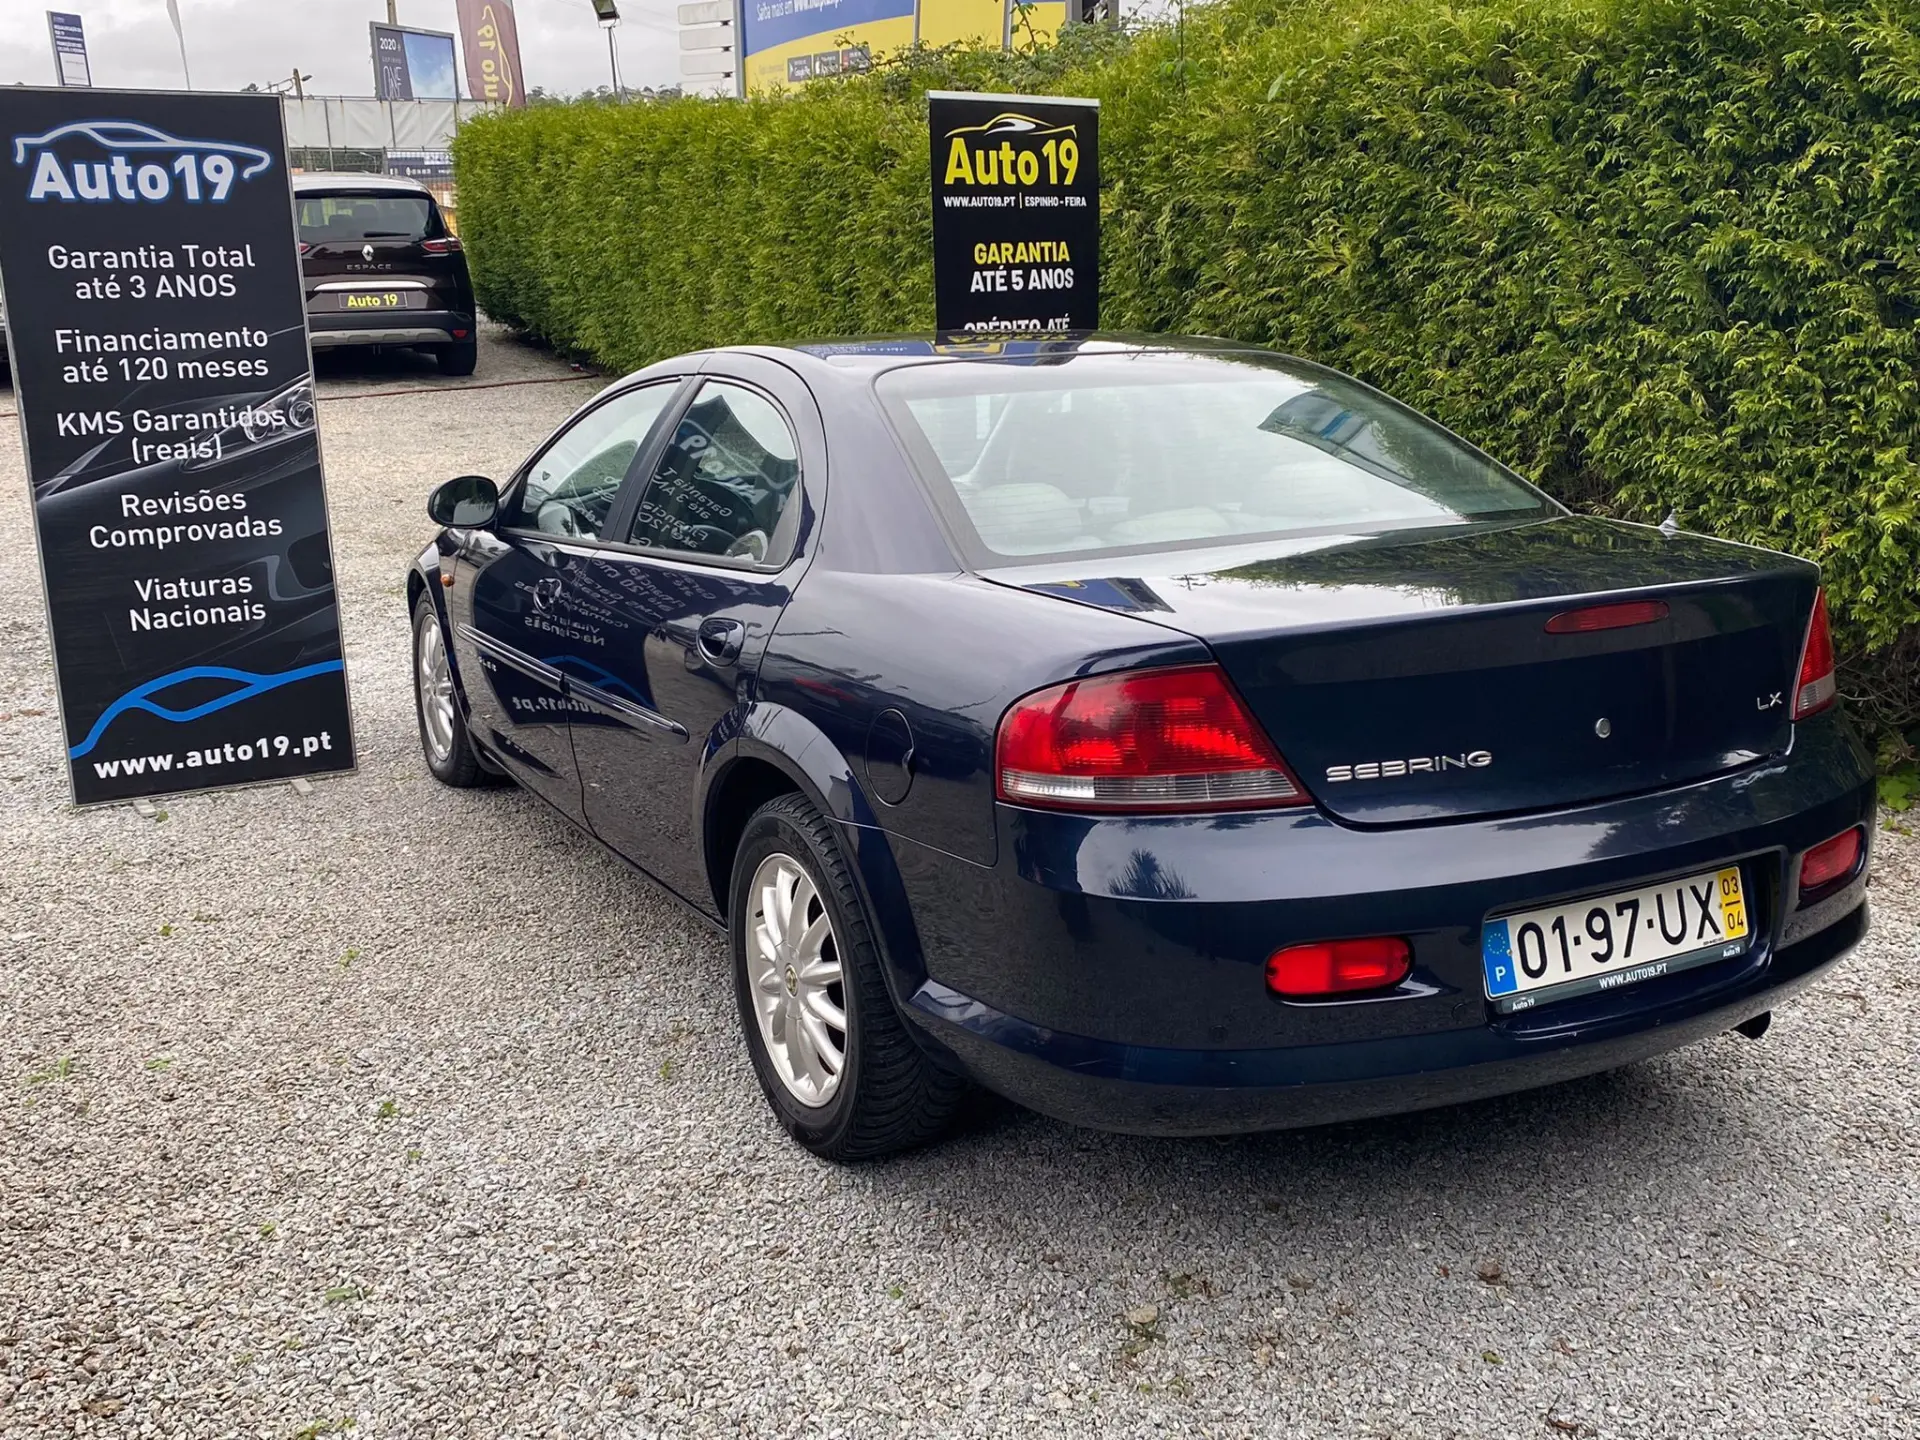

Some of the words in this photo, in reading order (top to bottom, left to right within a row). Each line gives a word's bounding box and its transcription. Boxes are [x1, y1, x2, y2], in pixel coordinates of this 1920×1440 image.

[380, 37, 397, 51] 2020
[943, 196, 1015, 208] WWW.AUTO19.PT
[1025, 196, 1058, 207] ESPINHO
[1064, 196, 1087, 207] FEIRA
[48, 245, 175, 269] Garantia
[182, 244, 255, 267] Total
[974, 241, 1070, 265] GARANTIA
[75, 275, 121, 300] até
[130, 276, 146, 298] 3
[155, 274, 237, 298] ANOS
[970, 265, 1008, 293] ATÉ
[1011, 269, 1024, 292] 5
[1028, 267, 1074, 290] ANOS
[55, 327, 269, 353] Financiamento
[63, 359, 108, 384] até
[118, 357, 168, 381] 120
[177, 358, 269, 379] meses
[57, 411, 124, 437] KMS
[132, 405, 287, 434] Garantidos
[131, 434, 222, 464] (reais)
[121, 489, 247, 517] Revisões
[89, 516, 283, 549] Comprovadas
[134, 575, 253, 602] Viaturas
[129, 600, 267, 632] Nacionais
[1756, 691, 1783, 711] LX
[93, 731, 332, 779] www.auto19.pt
[1326, 750, 1493, 783] SEBRING
[1722, 876, 1739, 896] 03
[1727, 912, 1744, 930] 04
[1495, 966, 1507, 982] P
[1599, 963, 1668, 989] WWW.AUTO19.PT
